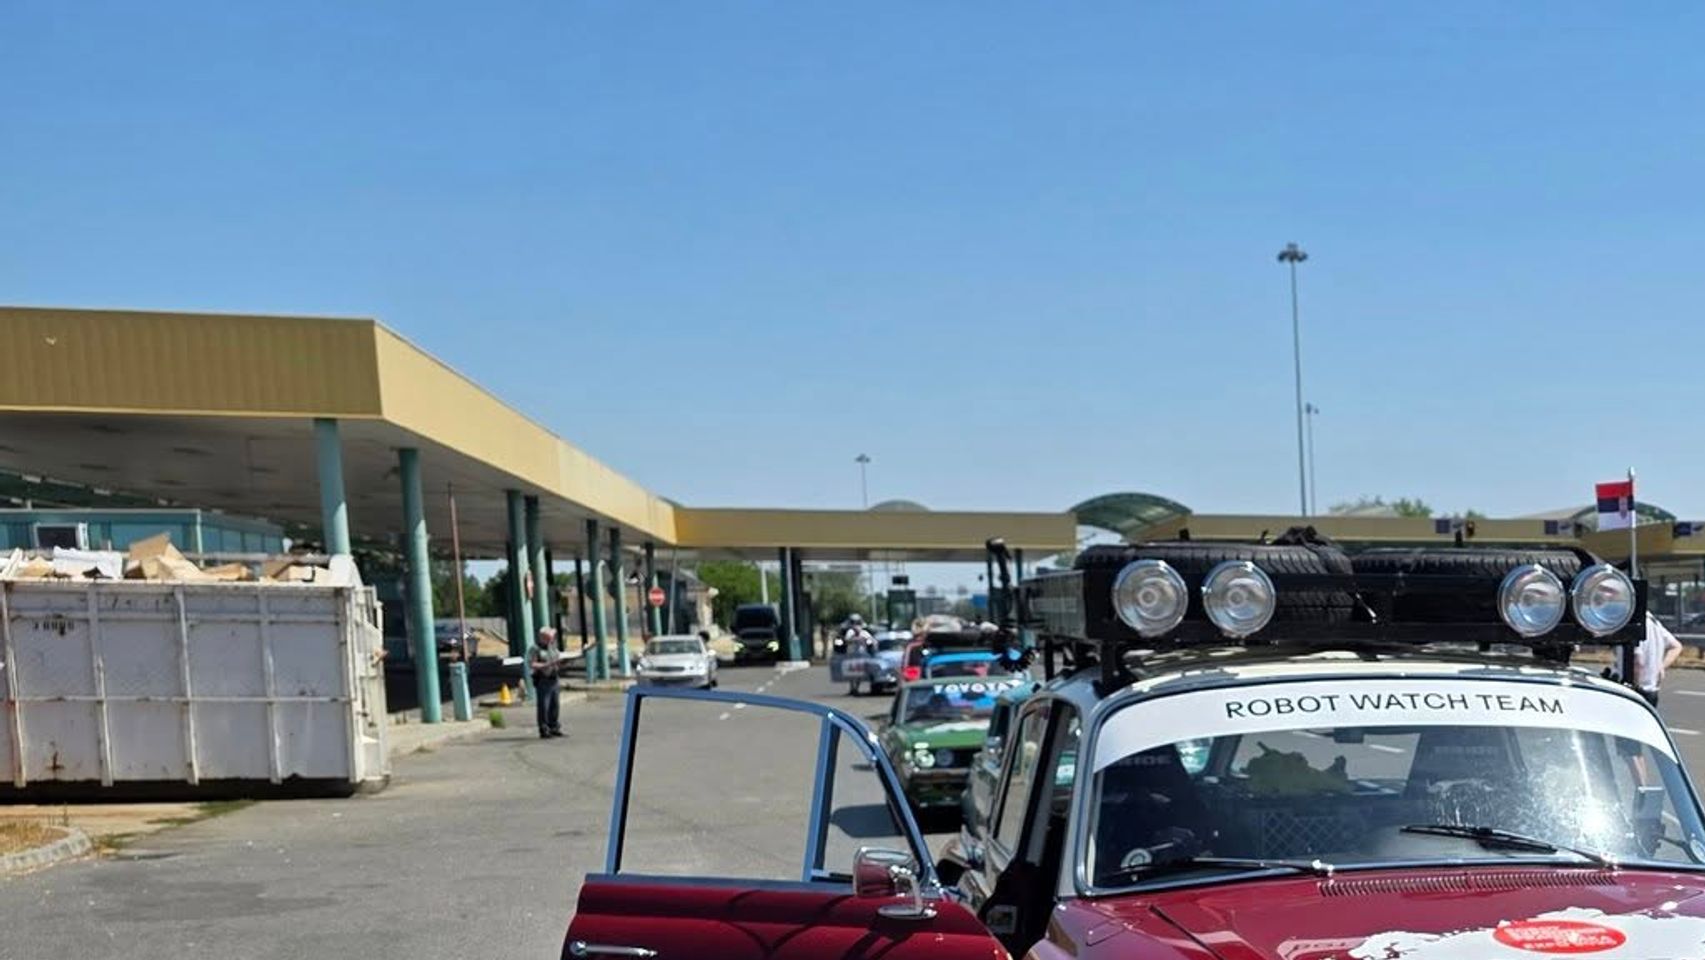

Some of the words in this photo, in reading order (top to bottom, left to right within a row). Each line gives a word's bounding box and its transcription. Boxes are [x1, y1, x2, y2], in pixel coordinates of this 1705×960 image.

[1225, 695, 1340, 718] ROBOT
[1349, 693, 1469, 710] WATCH
[1474, 694, 1564, 714] TEAM
